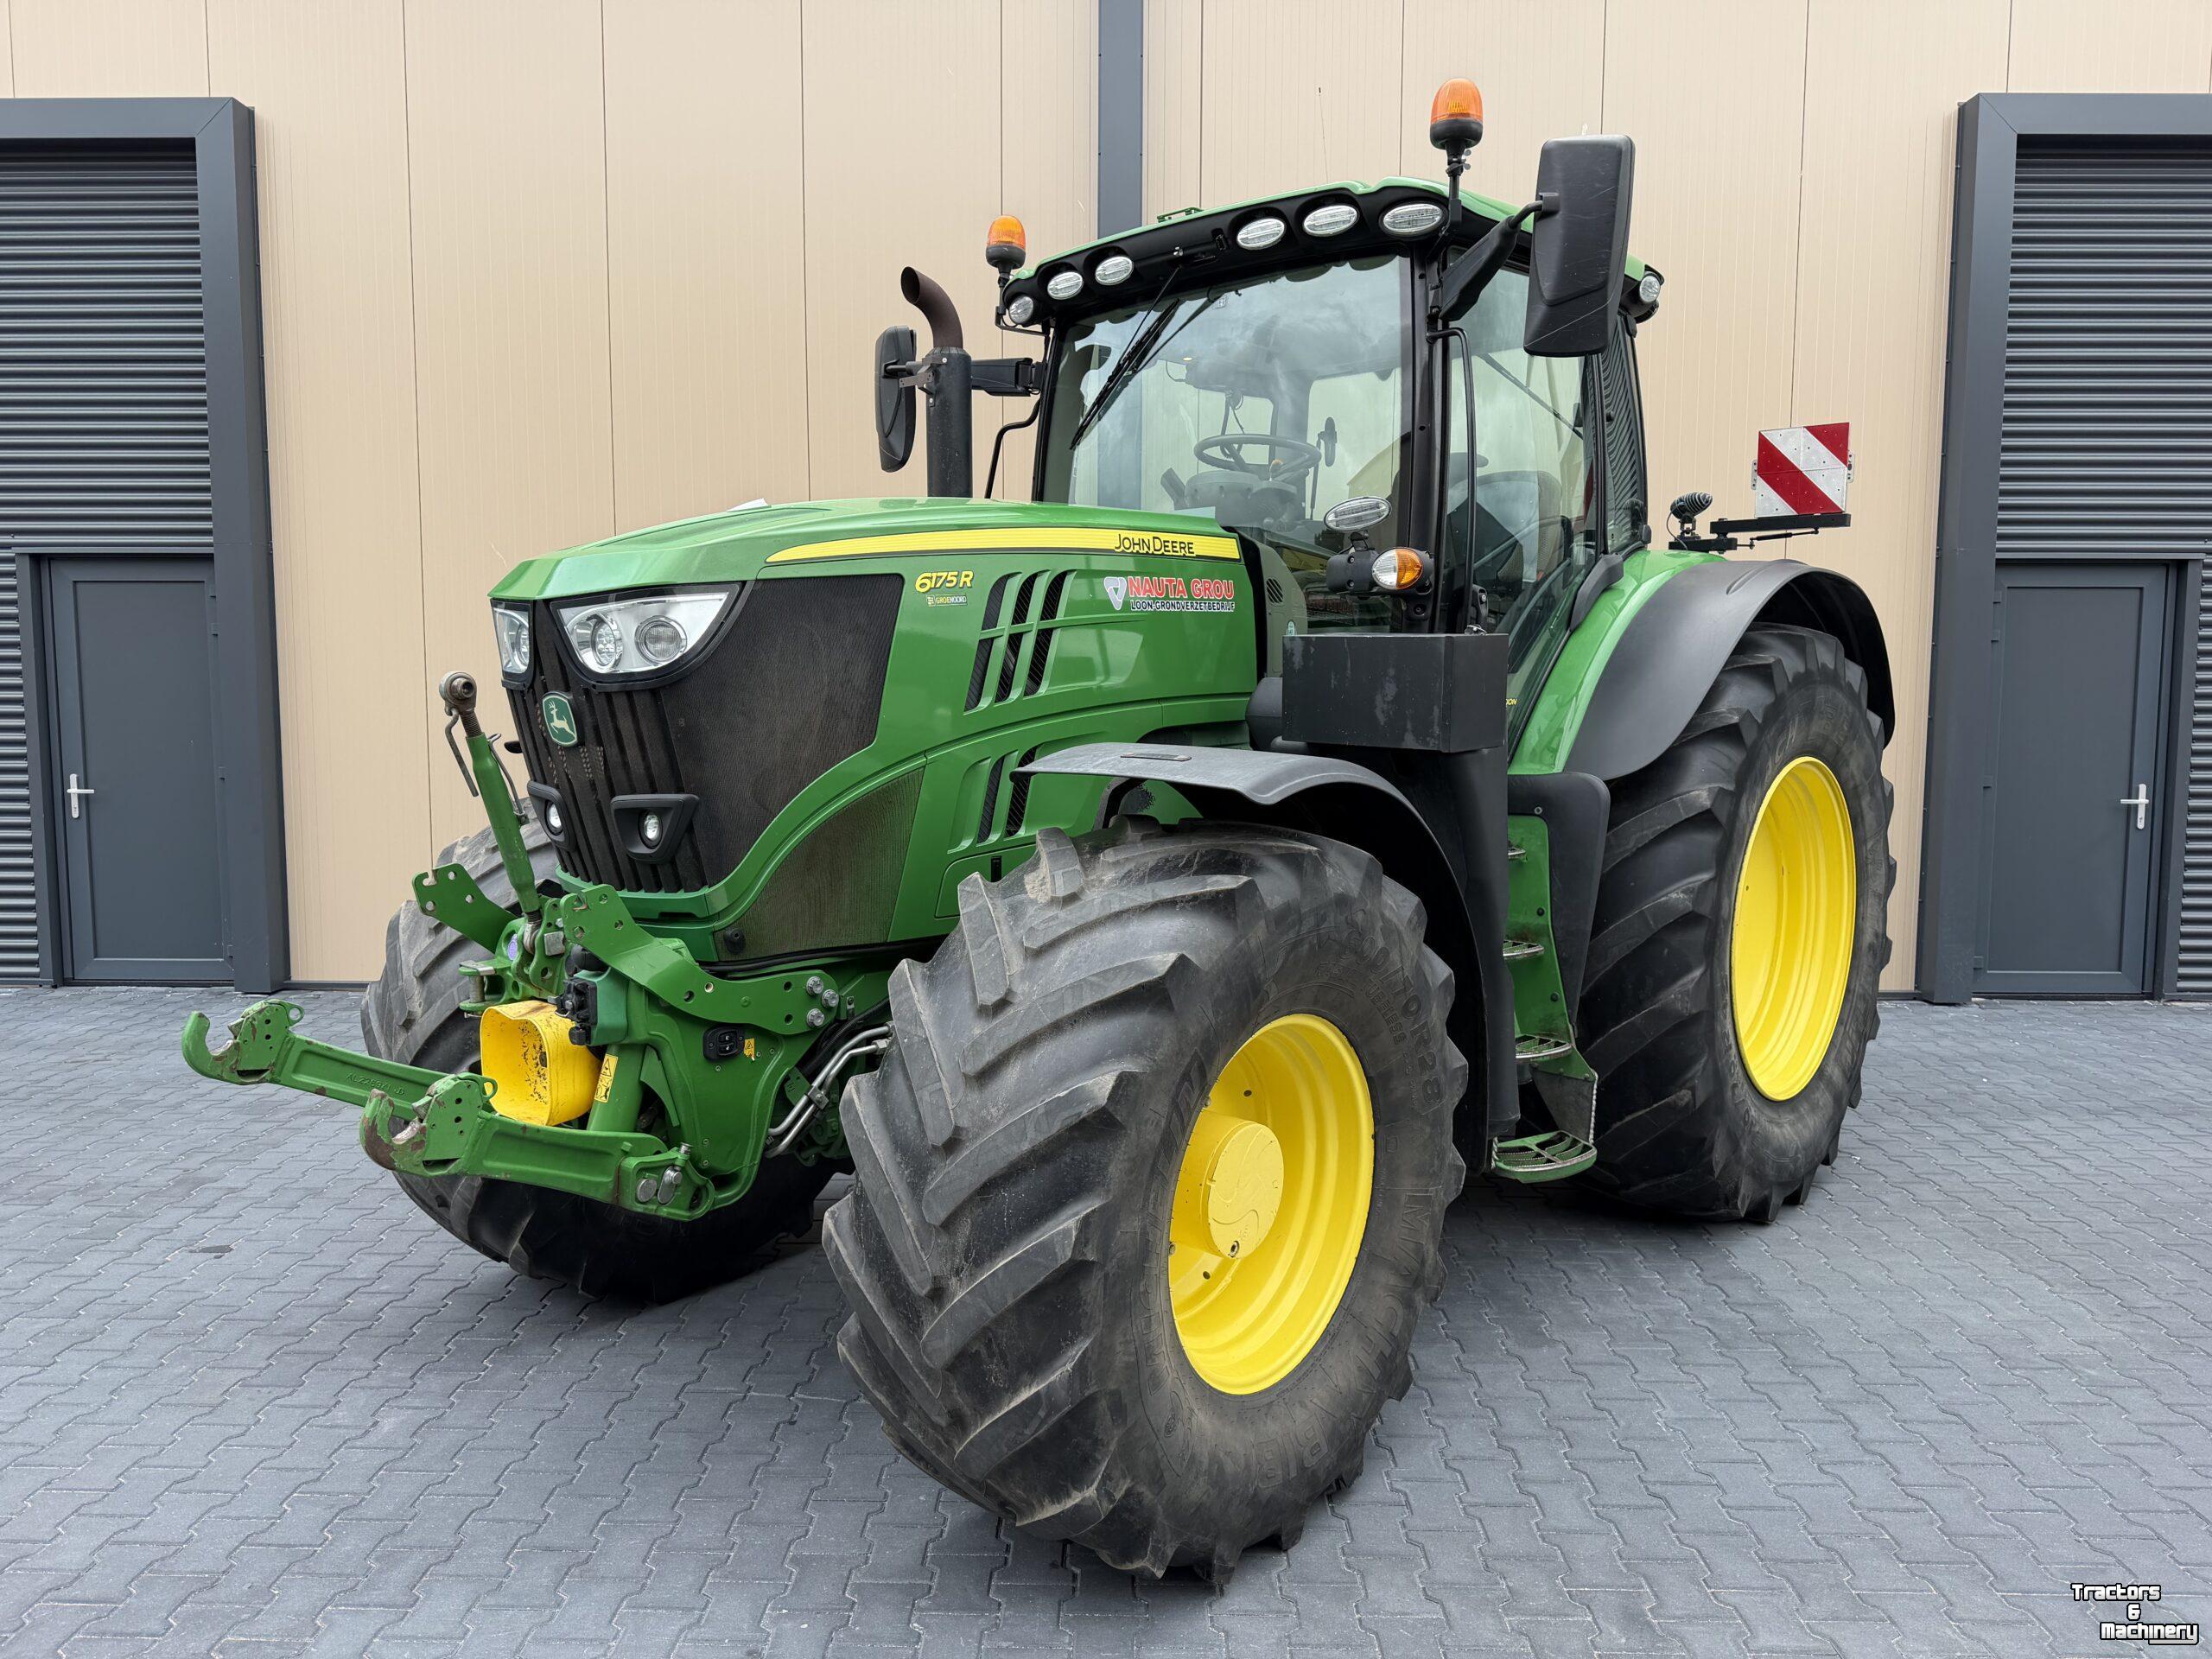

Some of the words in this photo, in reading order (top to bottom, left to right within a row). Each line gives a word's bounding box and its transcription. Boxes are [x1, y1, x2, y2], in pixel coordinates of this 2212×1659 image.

[1115, 533, 1150, 551] JOHN
[1153, 536, 1195, 554] DEERE
[1128, 576, 1187, 598] NAUTA
[1191, 579, 1235, 599] GROU
[1131, 600, 1236, 612] LOON-GRONDVERZETBEDRIJF
